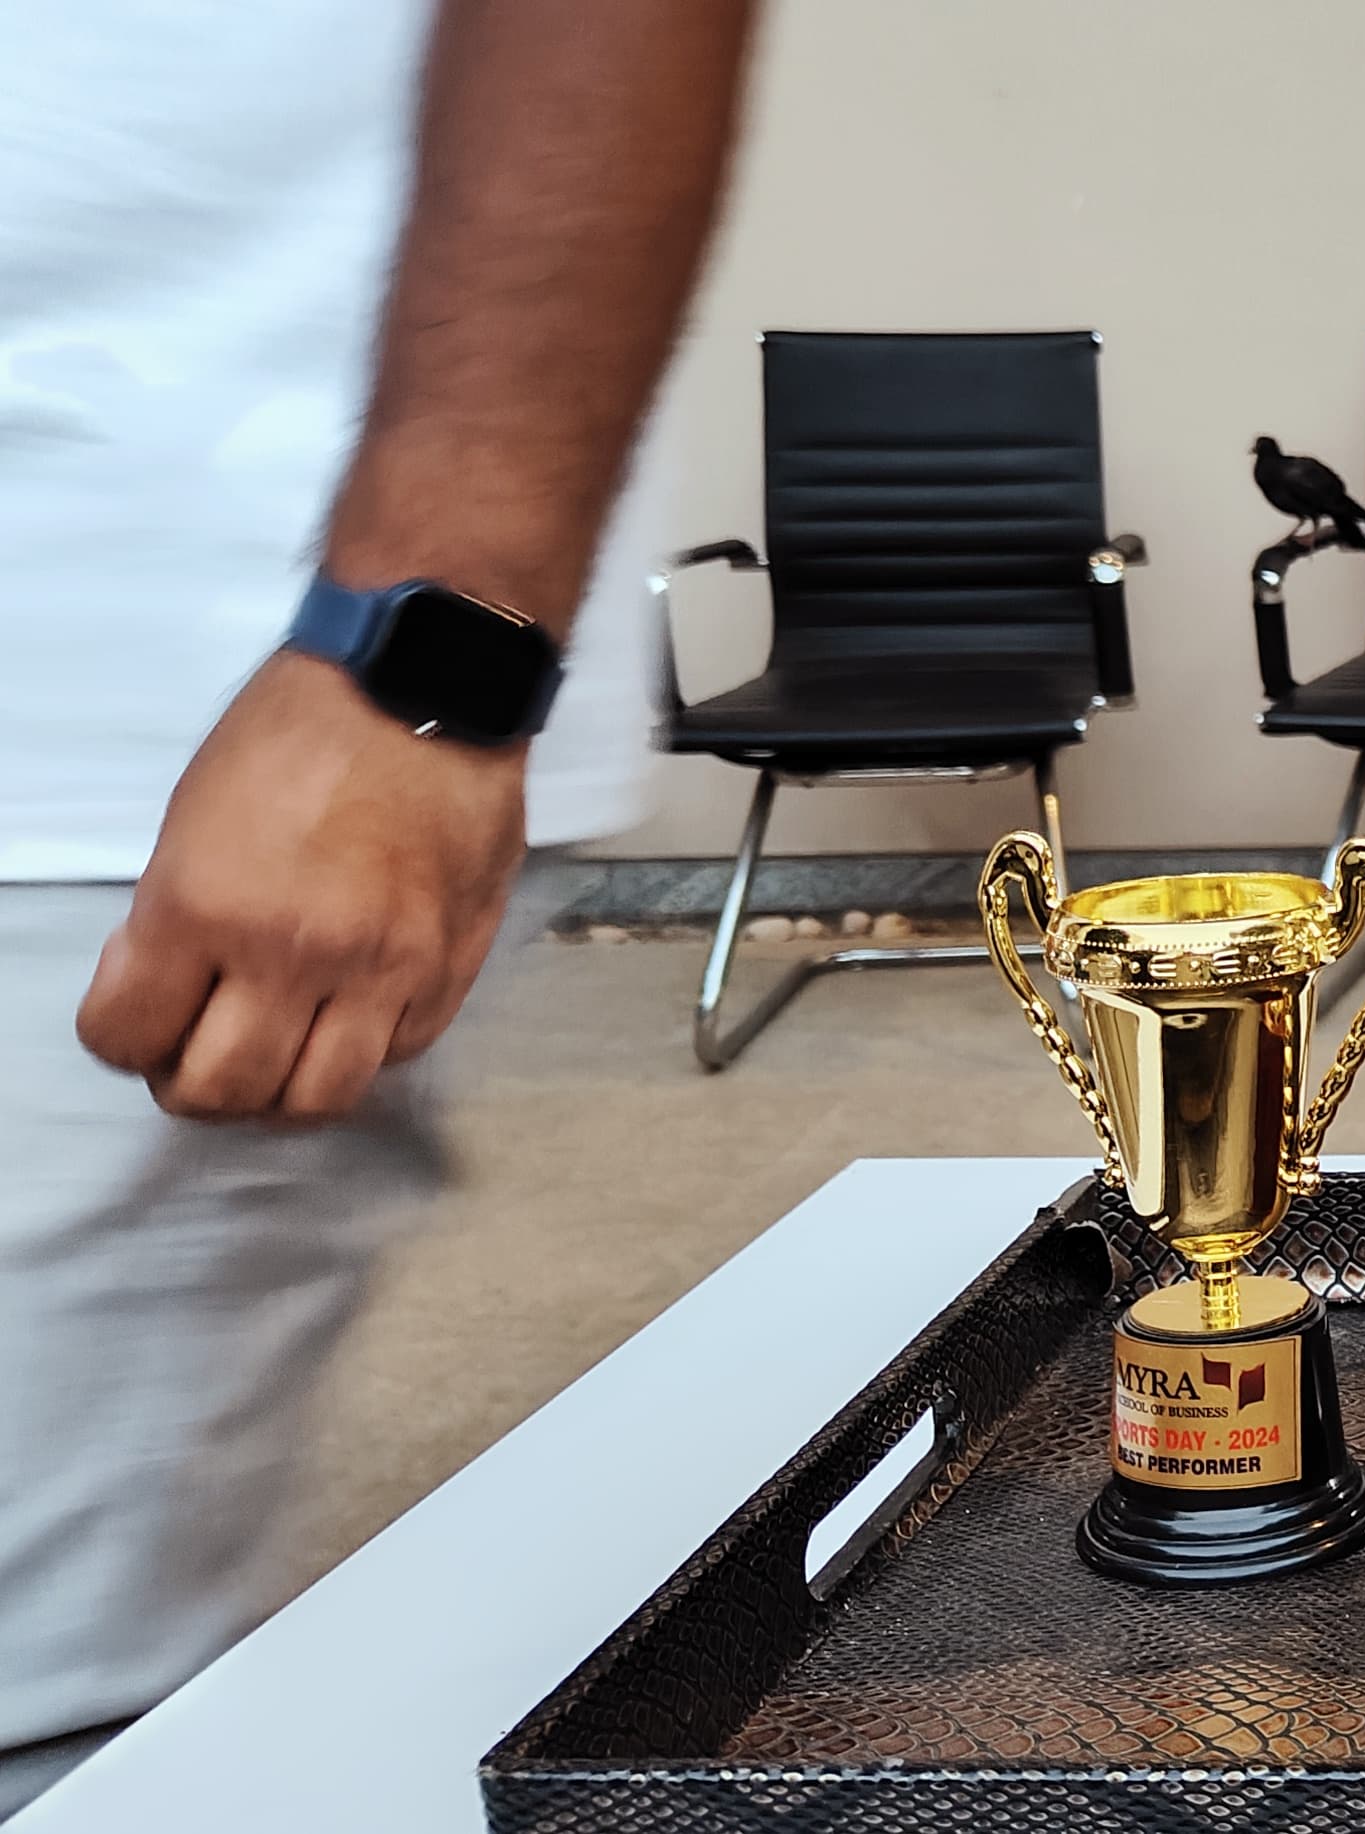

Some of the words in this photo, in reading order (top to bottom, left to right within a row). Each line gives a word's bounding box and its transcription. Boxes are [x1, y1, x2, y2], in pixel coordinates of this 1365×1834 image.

[1151, 1406, 1165, 1417] OF
[1169, 1407, 1228, 1418] BUSINESS
[1165, 1429, 1206, 1451] DAY
[1229, 1425, 1280, 1450] 2024
[1148, 1456, 1261, 1475] PERFORMER
